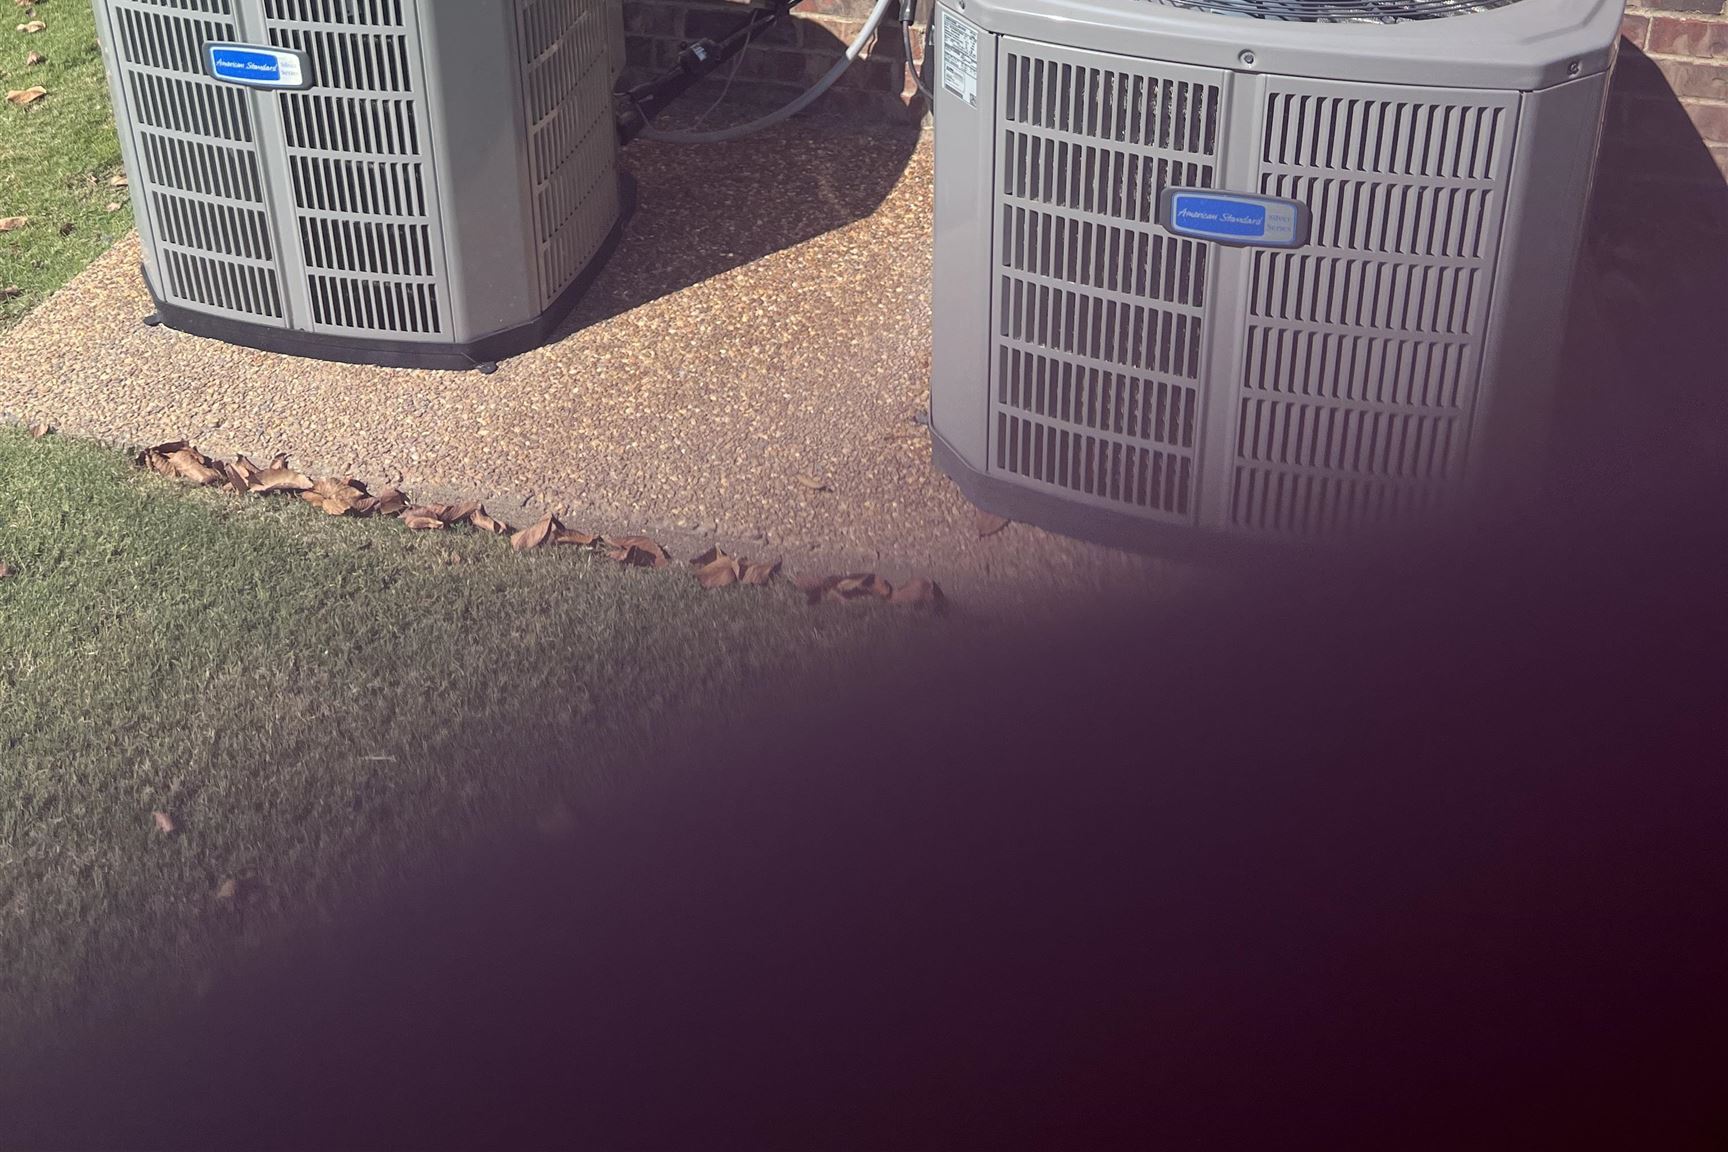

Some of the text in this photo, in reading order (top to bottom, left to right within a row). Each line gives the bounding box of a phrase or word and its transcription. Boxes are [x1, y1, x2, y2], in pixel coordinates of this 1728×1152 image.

[216, 58, 245, 68] American
[246, 61, 278, 72] Standard
[1178, 207, 1263, 225] American Standard
